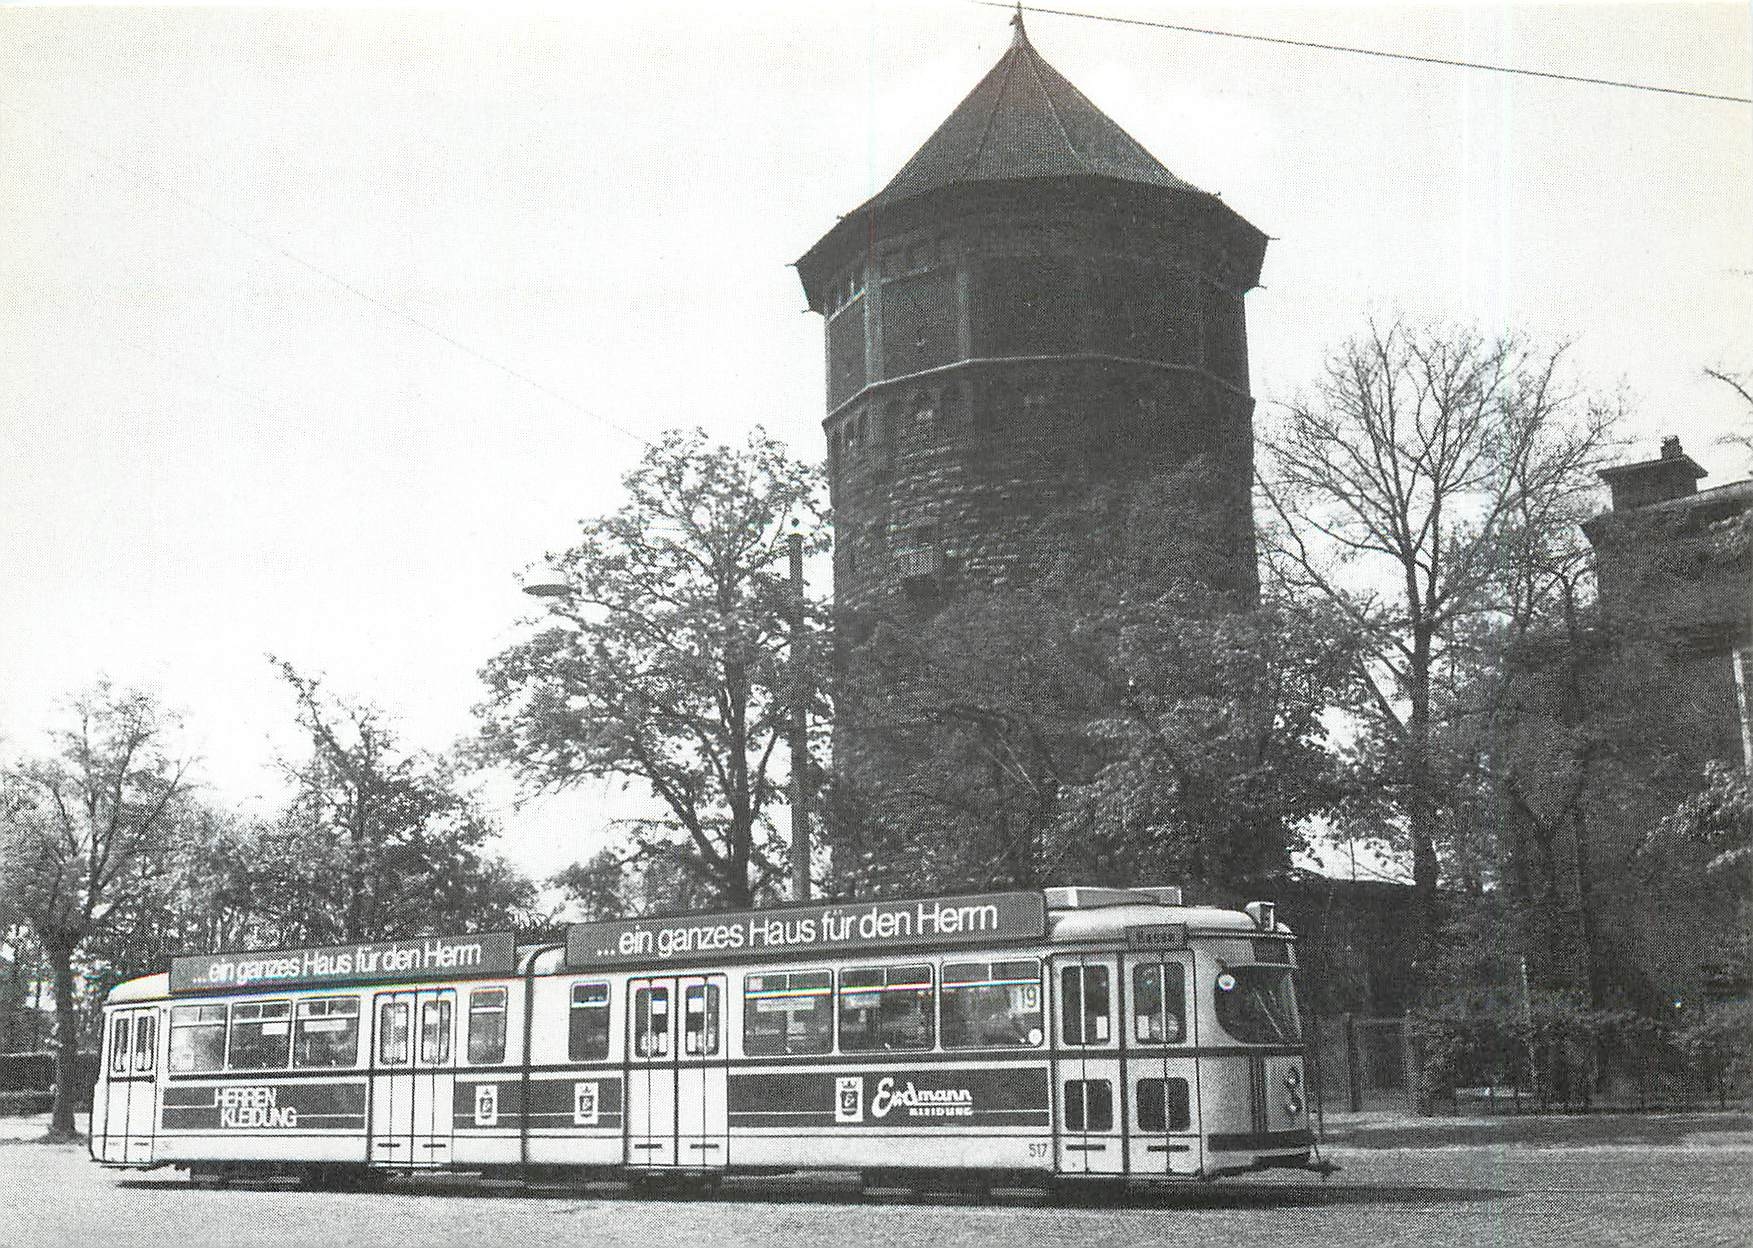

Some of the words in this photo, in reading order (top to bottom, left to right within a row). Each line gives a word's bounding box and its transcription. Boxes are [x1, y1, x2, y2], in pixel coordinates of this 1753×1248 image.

[658, 924, 744, 958] ganzes
[749, 918, 817, 947] Haus
[821, 909, 857, 942] für
[859, 906, 911, 939] den
[917, 903, 998, 935] Herrn
[237, 957, 301, 987] ganzes
[302, 951, 352, 976] Haus
[355, 944, 381, 973] für
[382, 943, 420, 972] den
[424, 940, 481, 968] Herrn
[214, 1087, 277, 1108] HERREN
[871, 1077, 973, 1118] Erdmann
[220, 1106, 297, 1128] KLEIDUNG
[1028, 1143, 1048, 1158] 517
